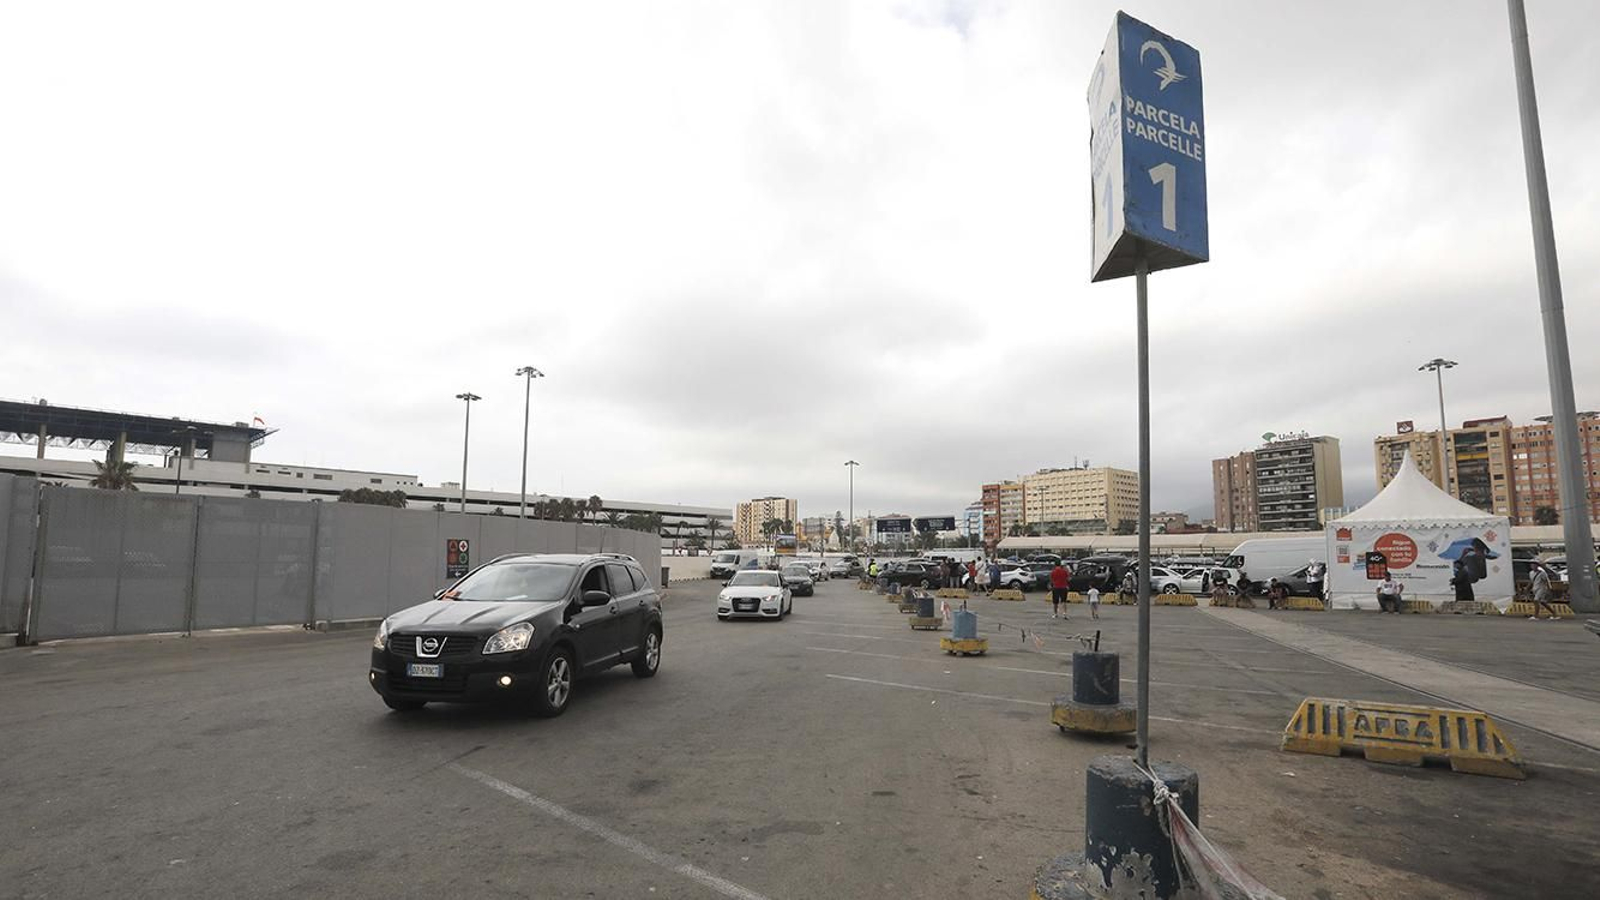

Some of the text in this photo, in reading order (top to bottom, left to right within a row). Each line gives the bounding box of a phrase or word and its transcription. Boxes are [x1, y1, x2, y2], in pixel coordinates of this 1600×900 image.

[1126, 95, 1200, 139] PARCELA
[1126, 120, 1203, 162] PARCELLE
[1148, 162, 1177, 232] 1
